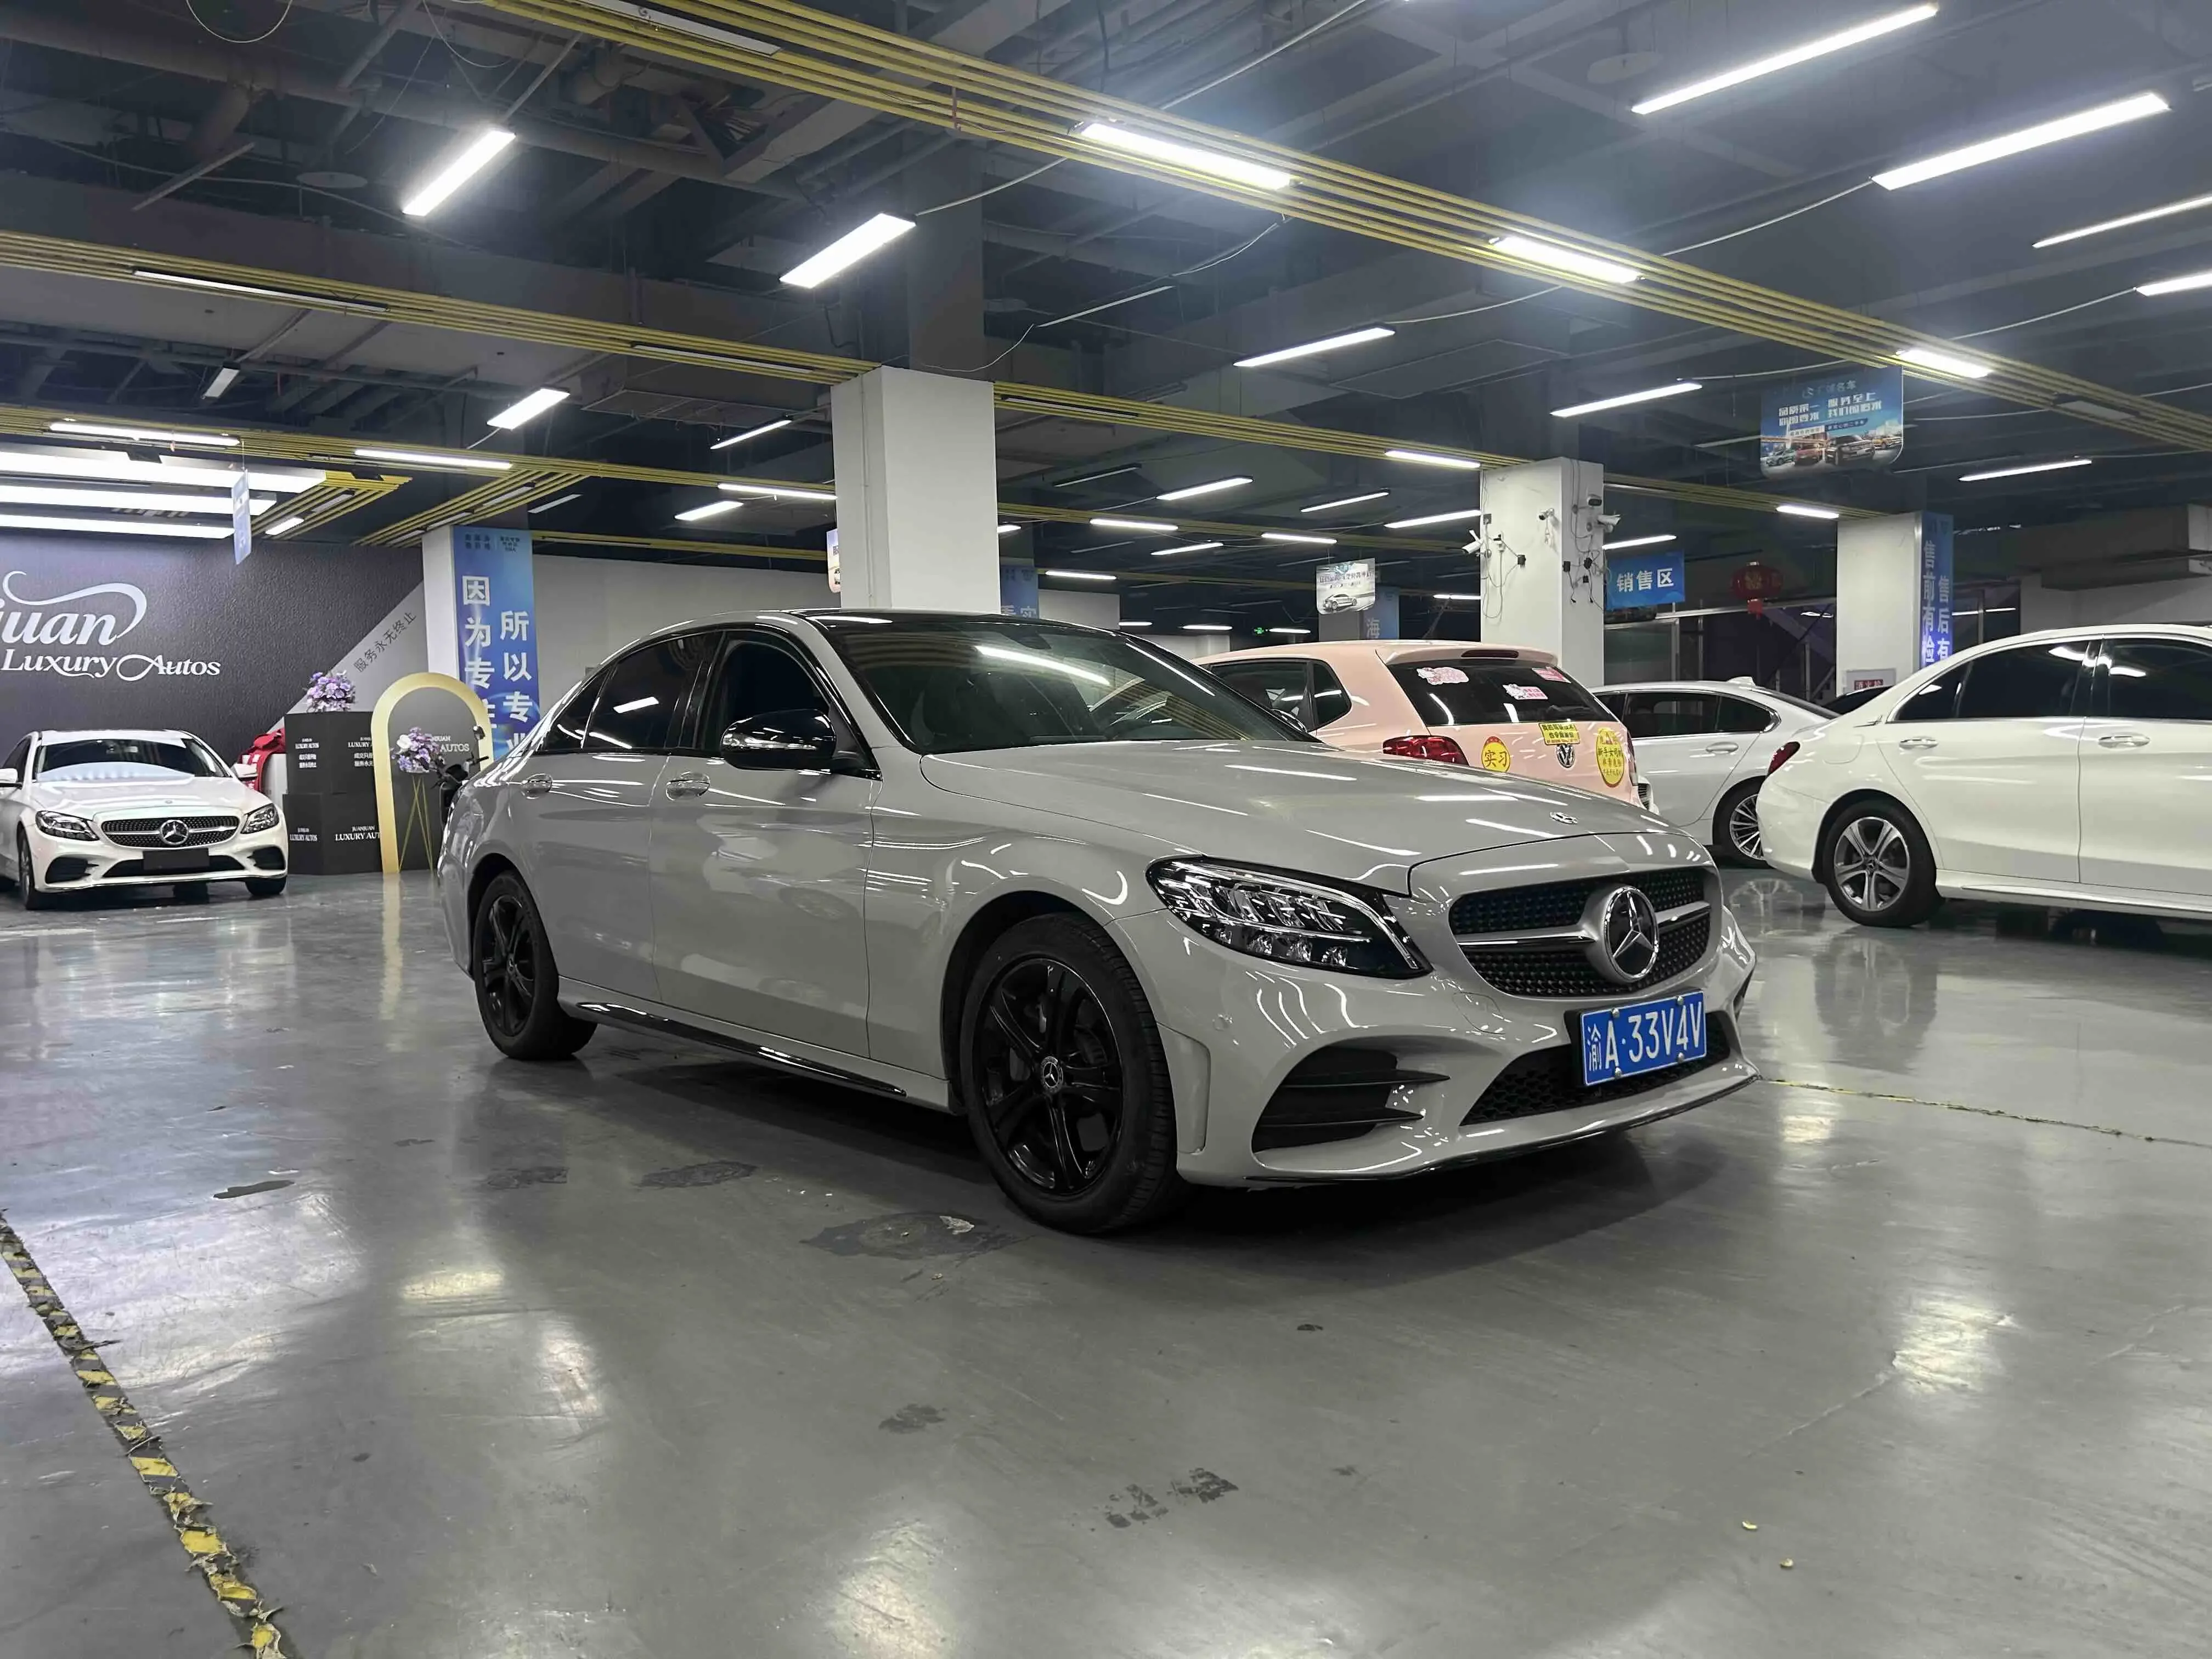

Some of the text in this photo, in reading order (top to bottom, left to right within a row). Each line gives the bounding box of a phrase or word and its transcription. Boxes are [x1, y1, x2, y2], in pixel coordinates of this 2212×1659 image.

[1617, 568, 1674, 592] 销售区
[0, 571, 147, 646] uan
[353, 612, 417, 672] 服务永无终止
[0, 648, 221, 681] Luxury Autos
[439, 743, 470, 752] AUTOS
[1484, 749, 1507, 768] 实习
